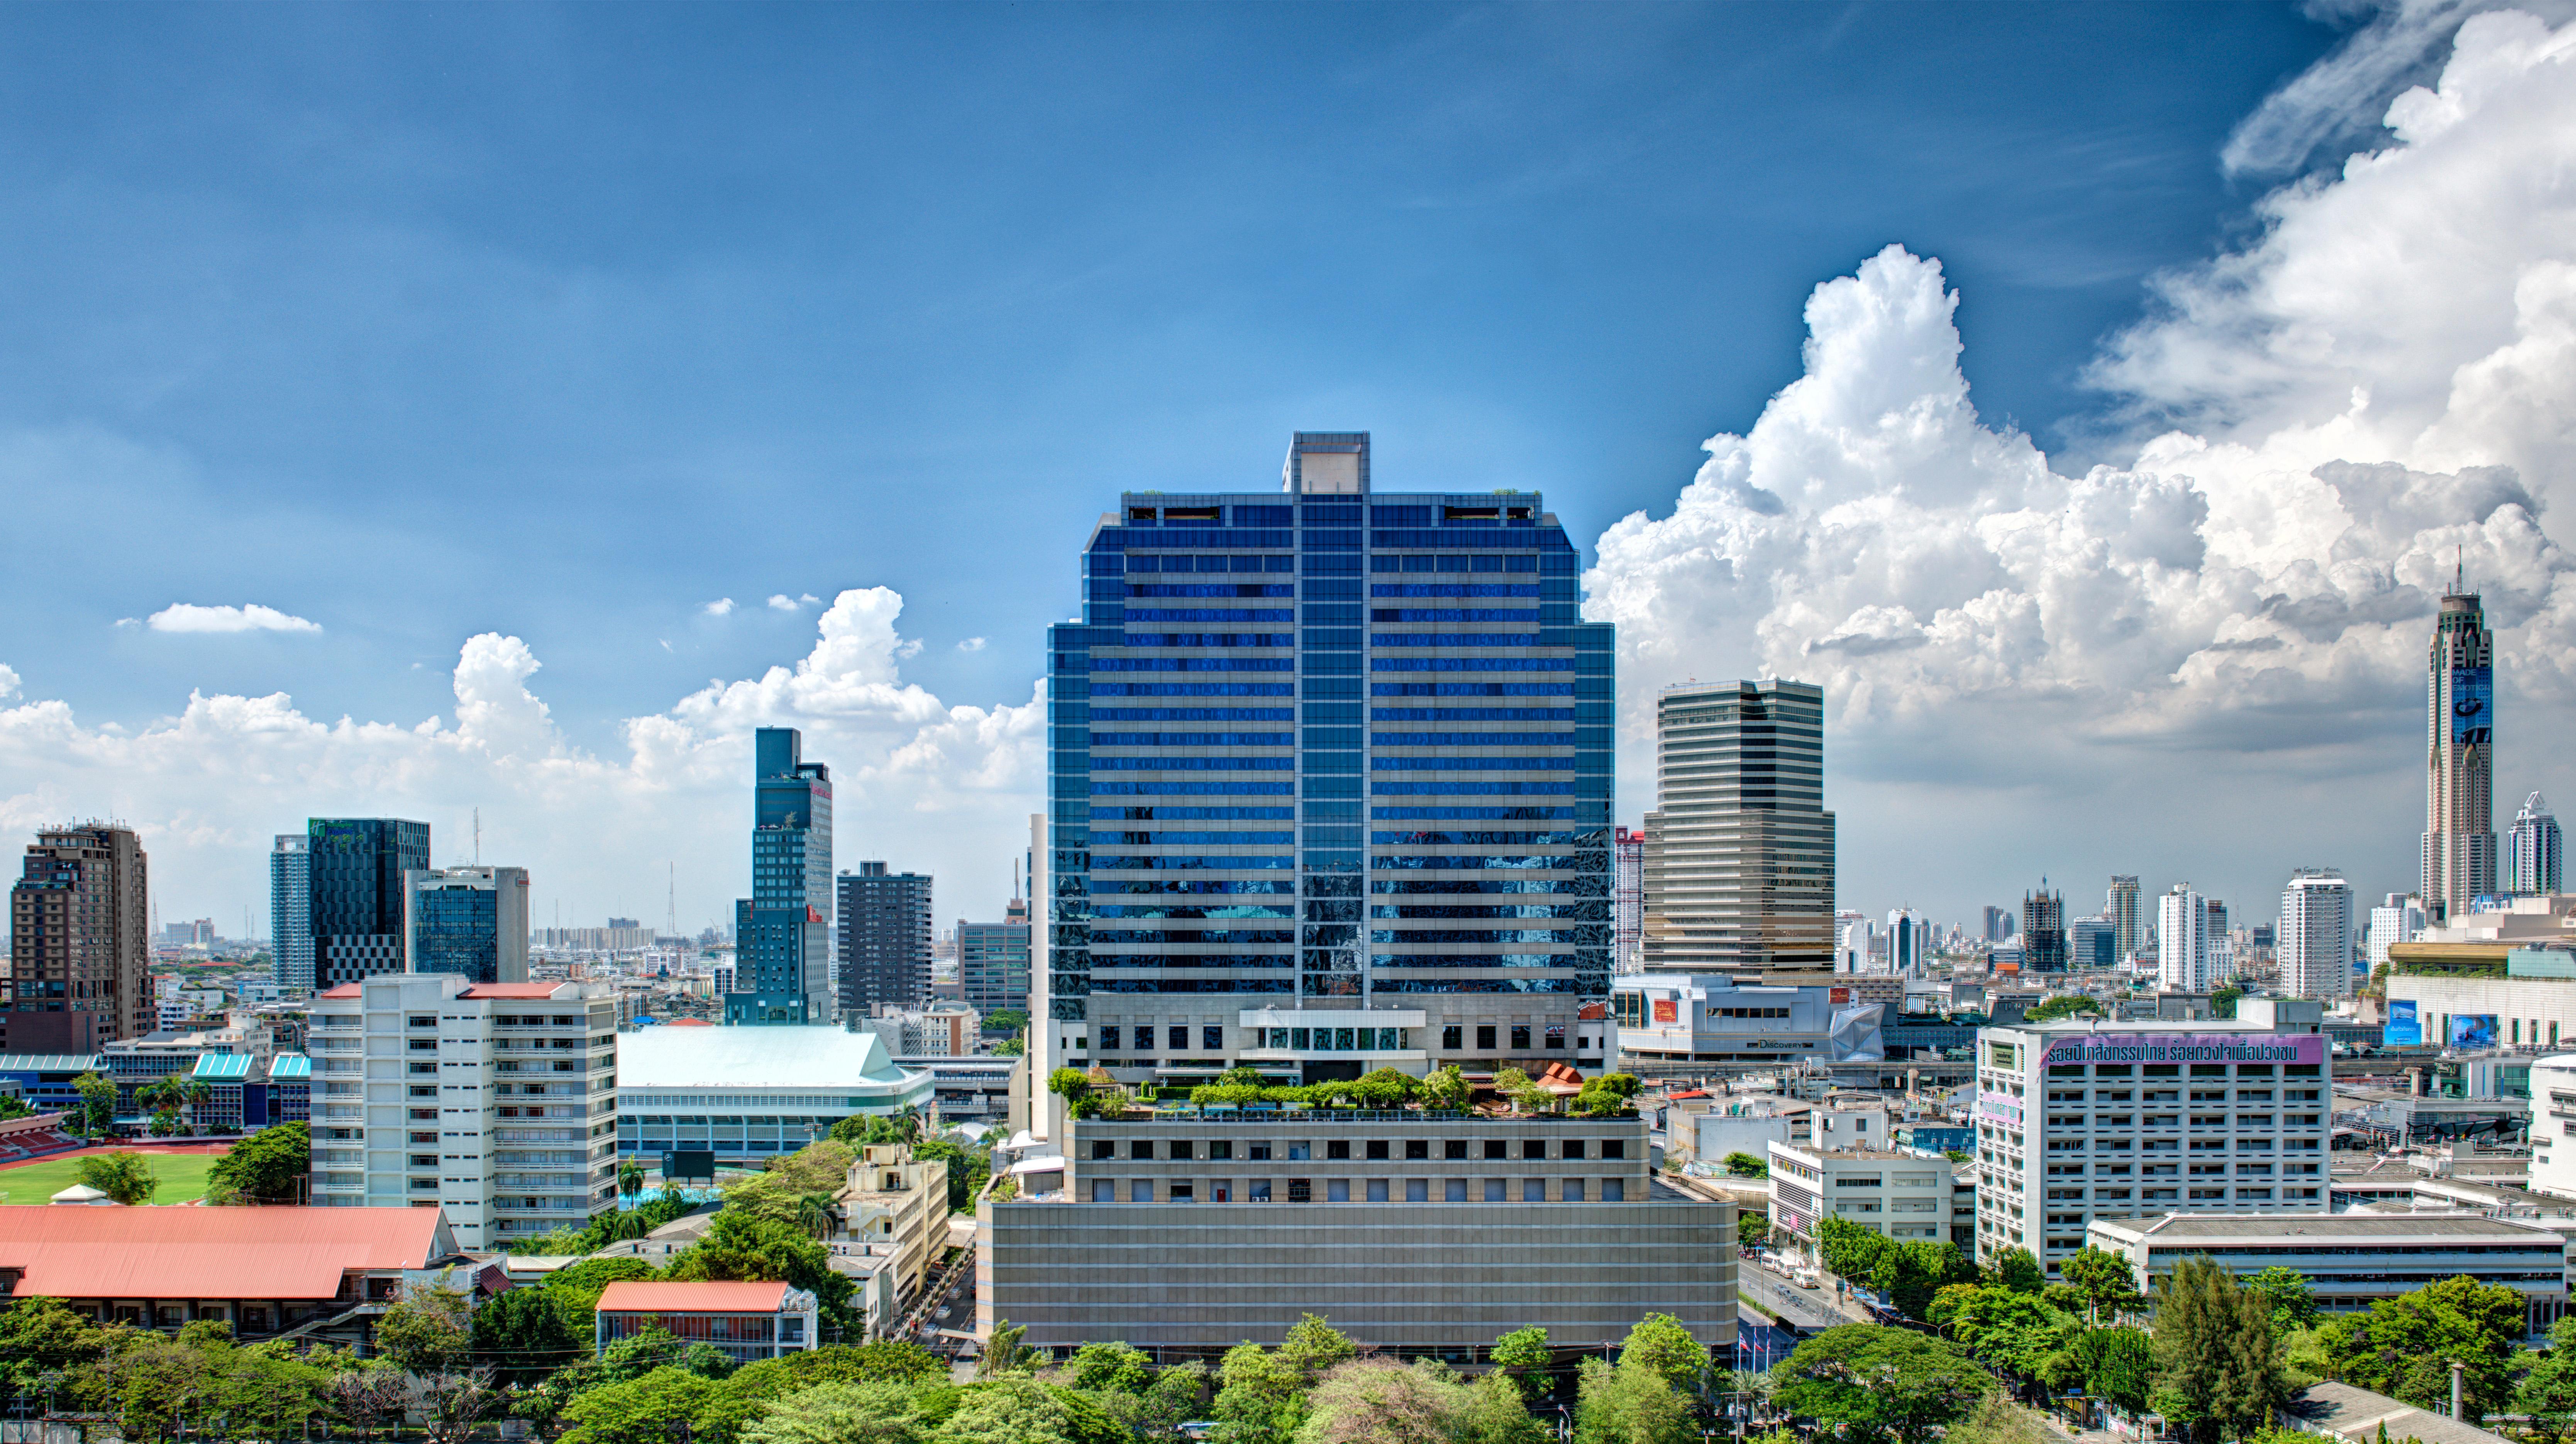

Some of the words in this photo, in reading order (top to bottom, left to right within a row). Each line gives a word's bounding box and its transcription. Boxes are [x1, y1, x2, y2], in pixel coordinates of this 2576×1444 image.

[2048, 1043, 2166, 1062] รอยปีเภสัชกรรมไทย
[2170, 1037, 2297, 1061] ร้อยดวงใจเพื่อปวงชน
